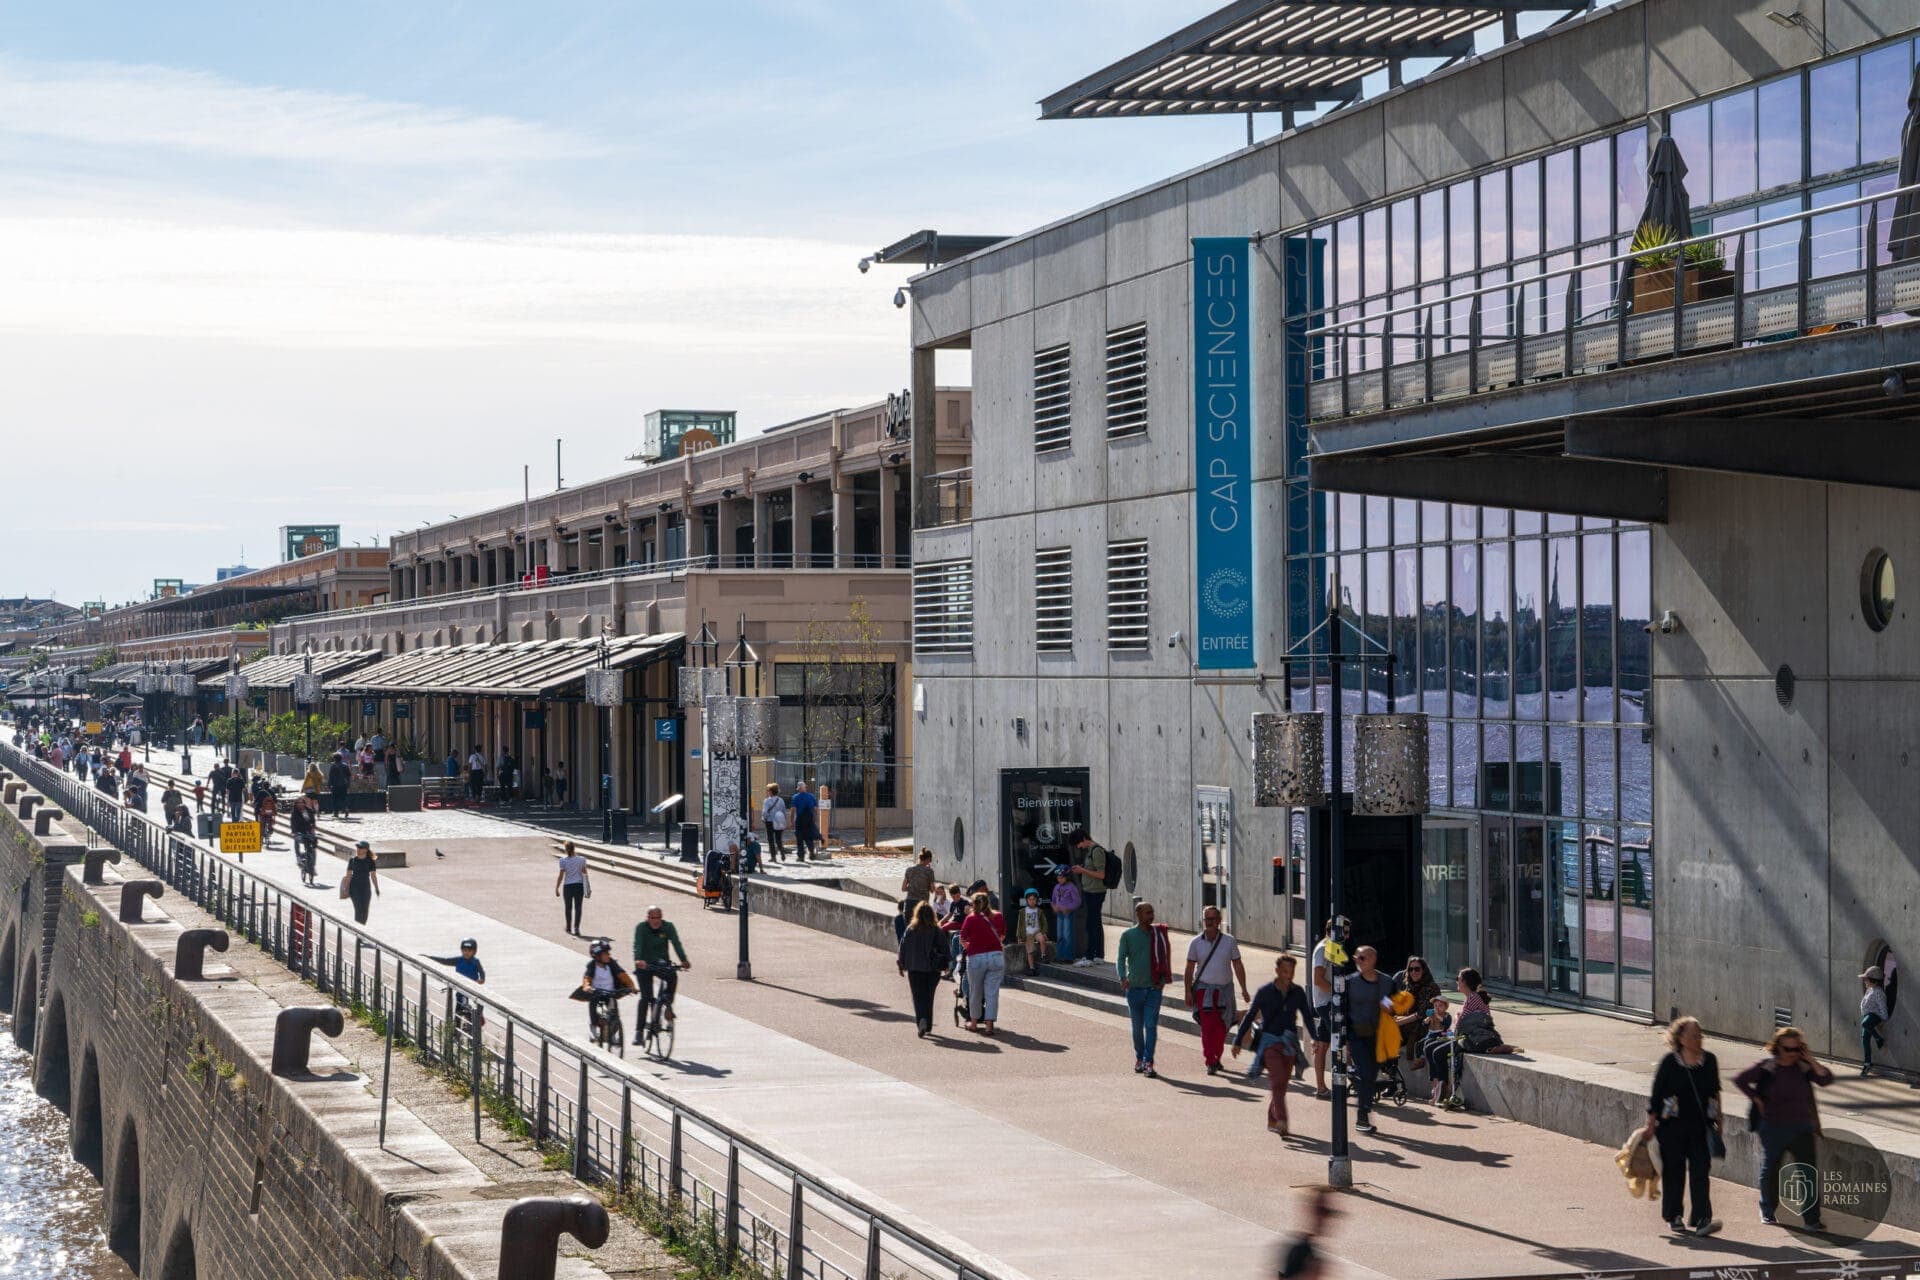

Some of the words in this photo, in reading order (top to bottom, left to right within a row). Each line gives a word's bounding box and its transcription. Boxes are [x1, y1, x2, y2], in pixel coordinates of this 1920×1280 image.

[1207, 254, 1237, 441] SCIENCES
[1209, 458, 1238, 532] CAP
[305, 542, 322, 552] H18
[1202, 633, 1249, 650] ENTRÉE
[1017, 797, 1074, 808] Bienvenue
[1422, 859, 1467, 881] NTRÉE
